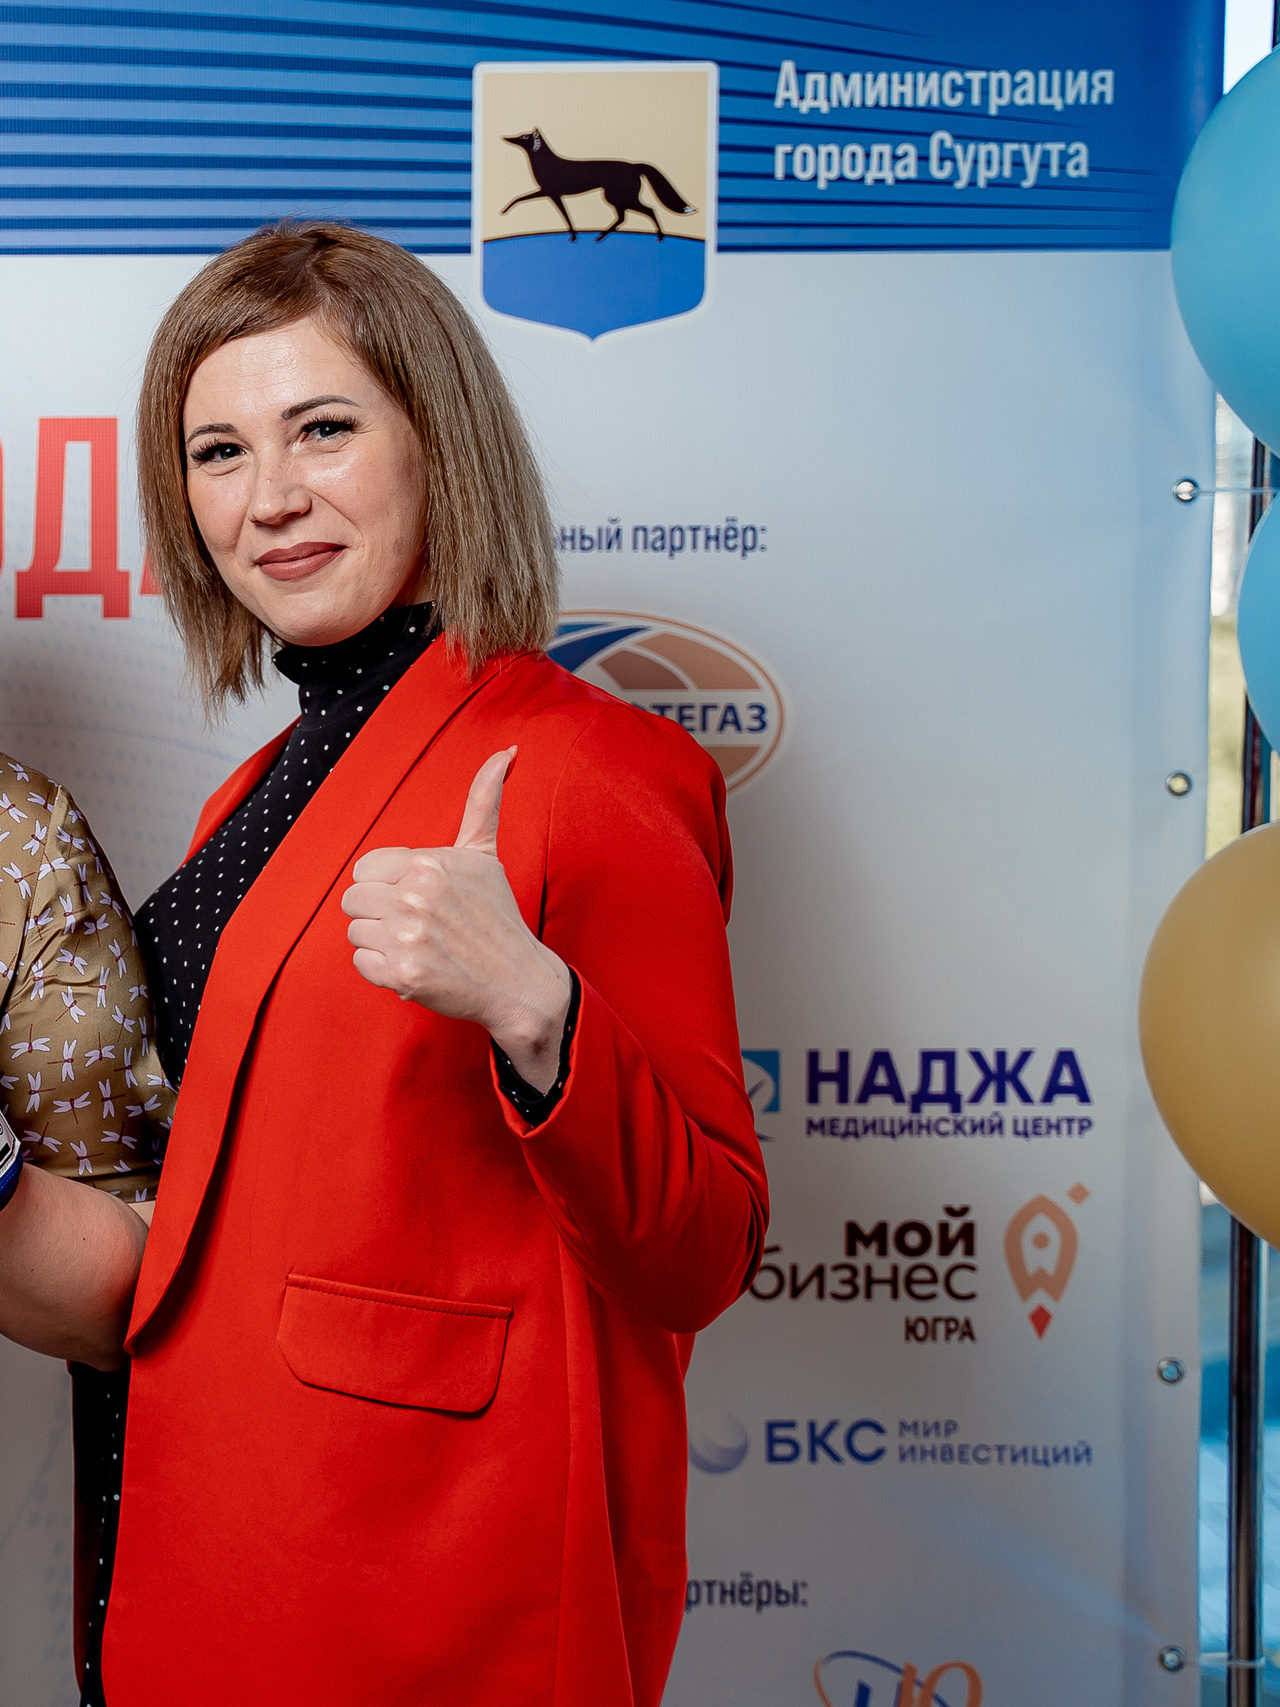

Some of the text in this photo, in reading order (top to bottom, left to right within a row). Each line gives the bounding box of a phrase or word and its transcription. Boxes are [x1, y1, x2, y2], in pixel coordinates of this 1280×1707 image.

[773, 60, 1115, 115] Администрация
[774, 130, 1090, 189] города Сургута
[558, 516, 767, 559] ный партнёр:
[631, 702, 768, 734] ТЕГАЗ
[805, 1049, 1093, 1114] НАДЖА
[805, 1112, 1094, 1139] МЕДИЦИНСКИЙ ЦЕНТР
[749, 1244, 977, 1302] бизнес
[905, 1316, 976, 1344] ЮГРА
[765, 1419, 889, 1465] БКС
[898, 1420, 958, 1438] МИР
[898, 1440, 1093, 1466] ИНВЕСТИЦИЙ
